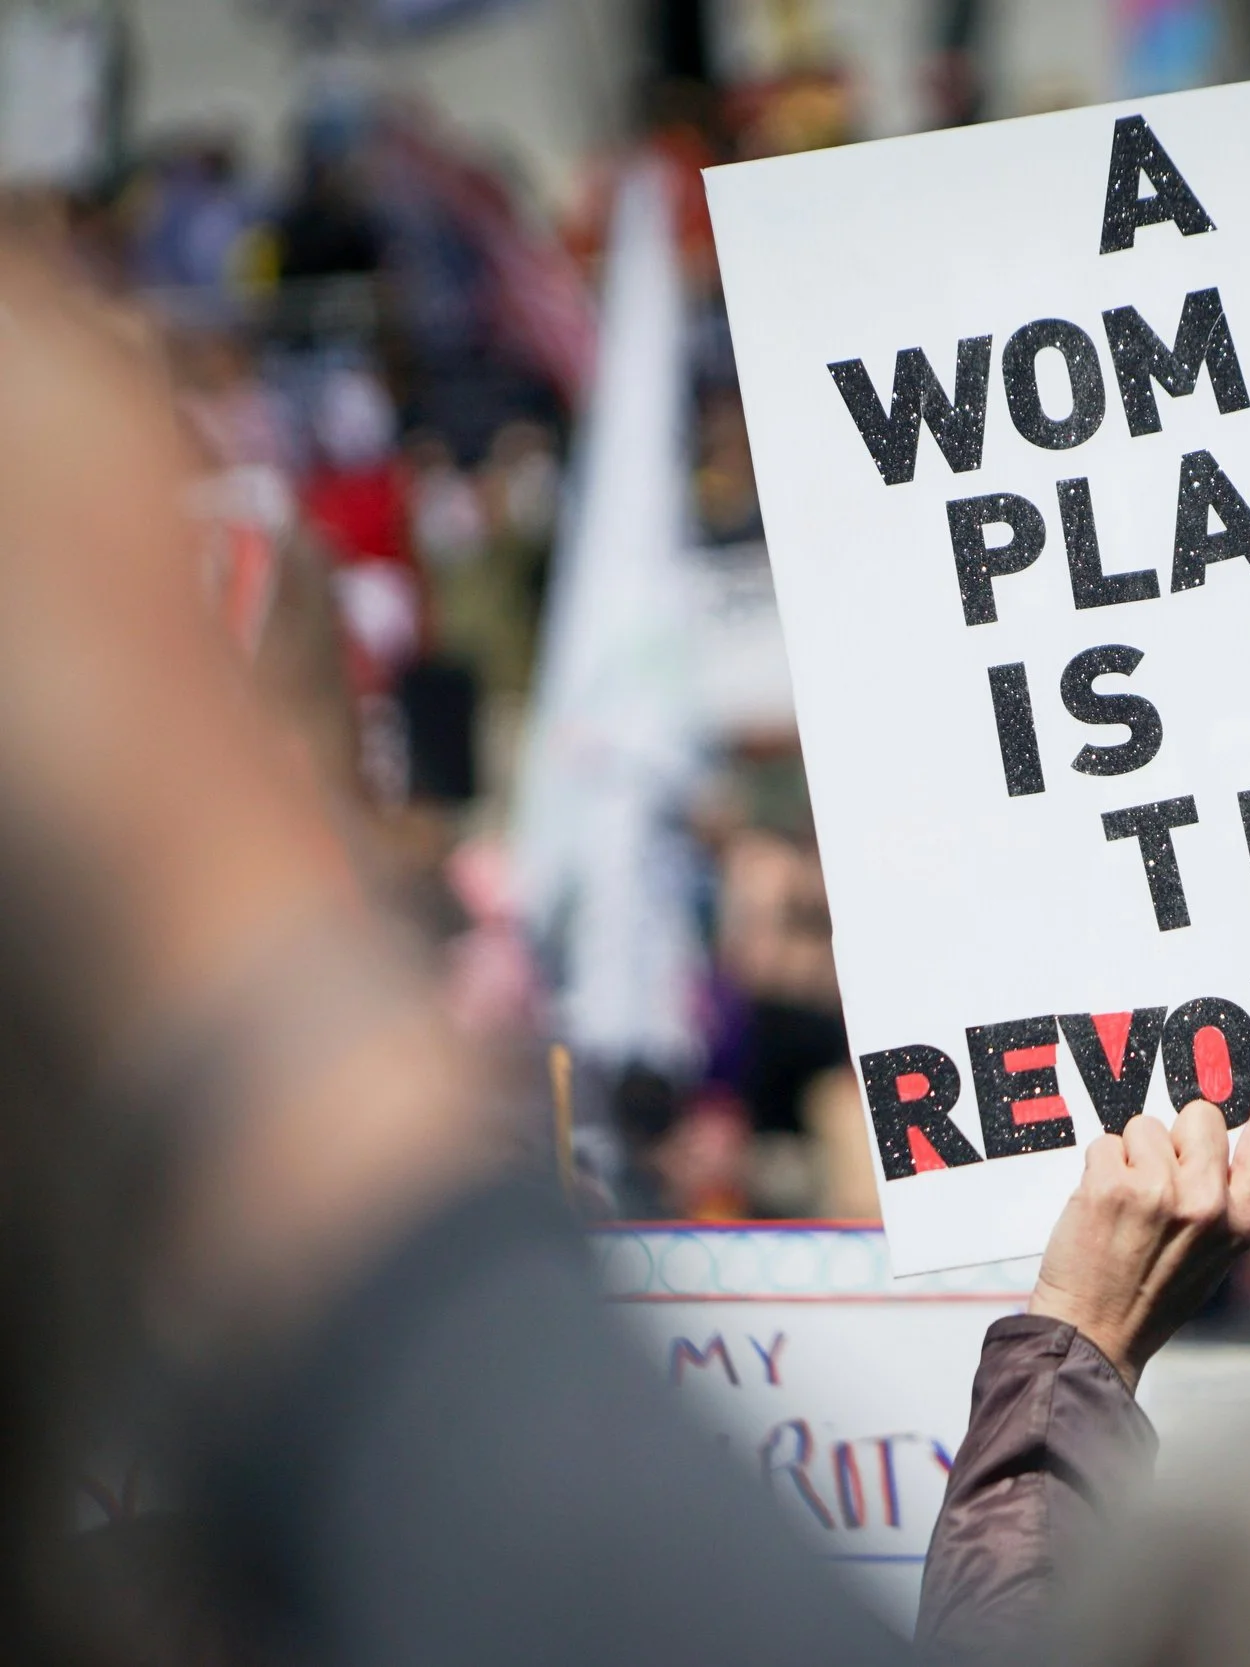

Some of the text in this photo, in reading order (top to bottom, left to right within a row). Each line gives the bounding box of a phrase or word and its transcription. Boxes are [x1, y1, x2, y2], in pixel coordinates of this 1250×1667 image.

[1099, 114, 1217, 255] A
[987, 643, 1164, 798] IS
[670, 1331, 787, 1387] MY
